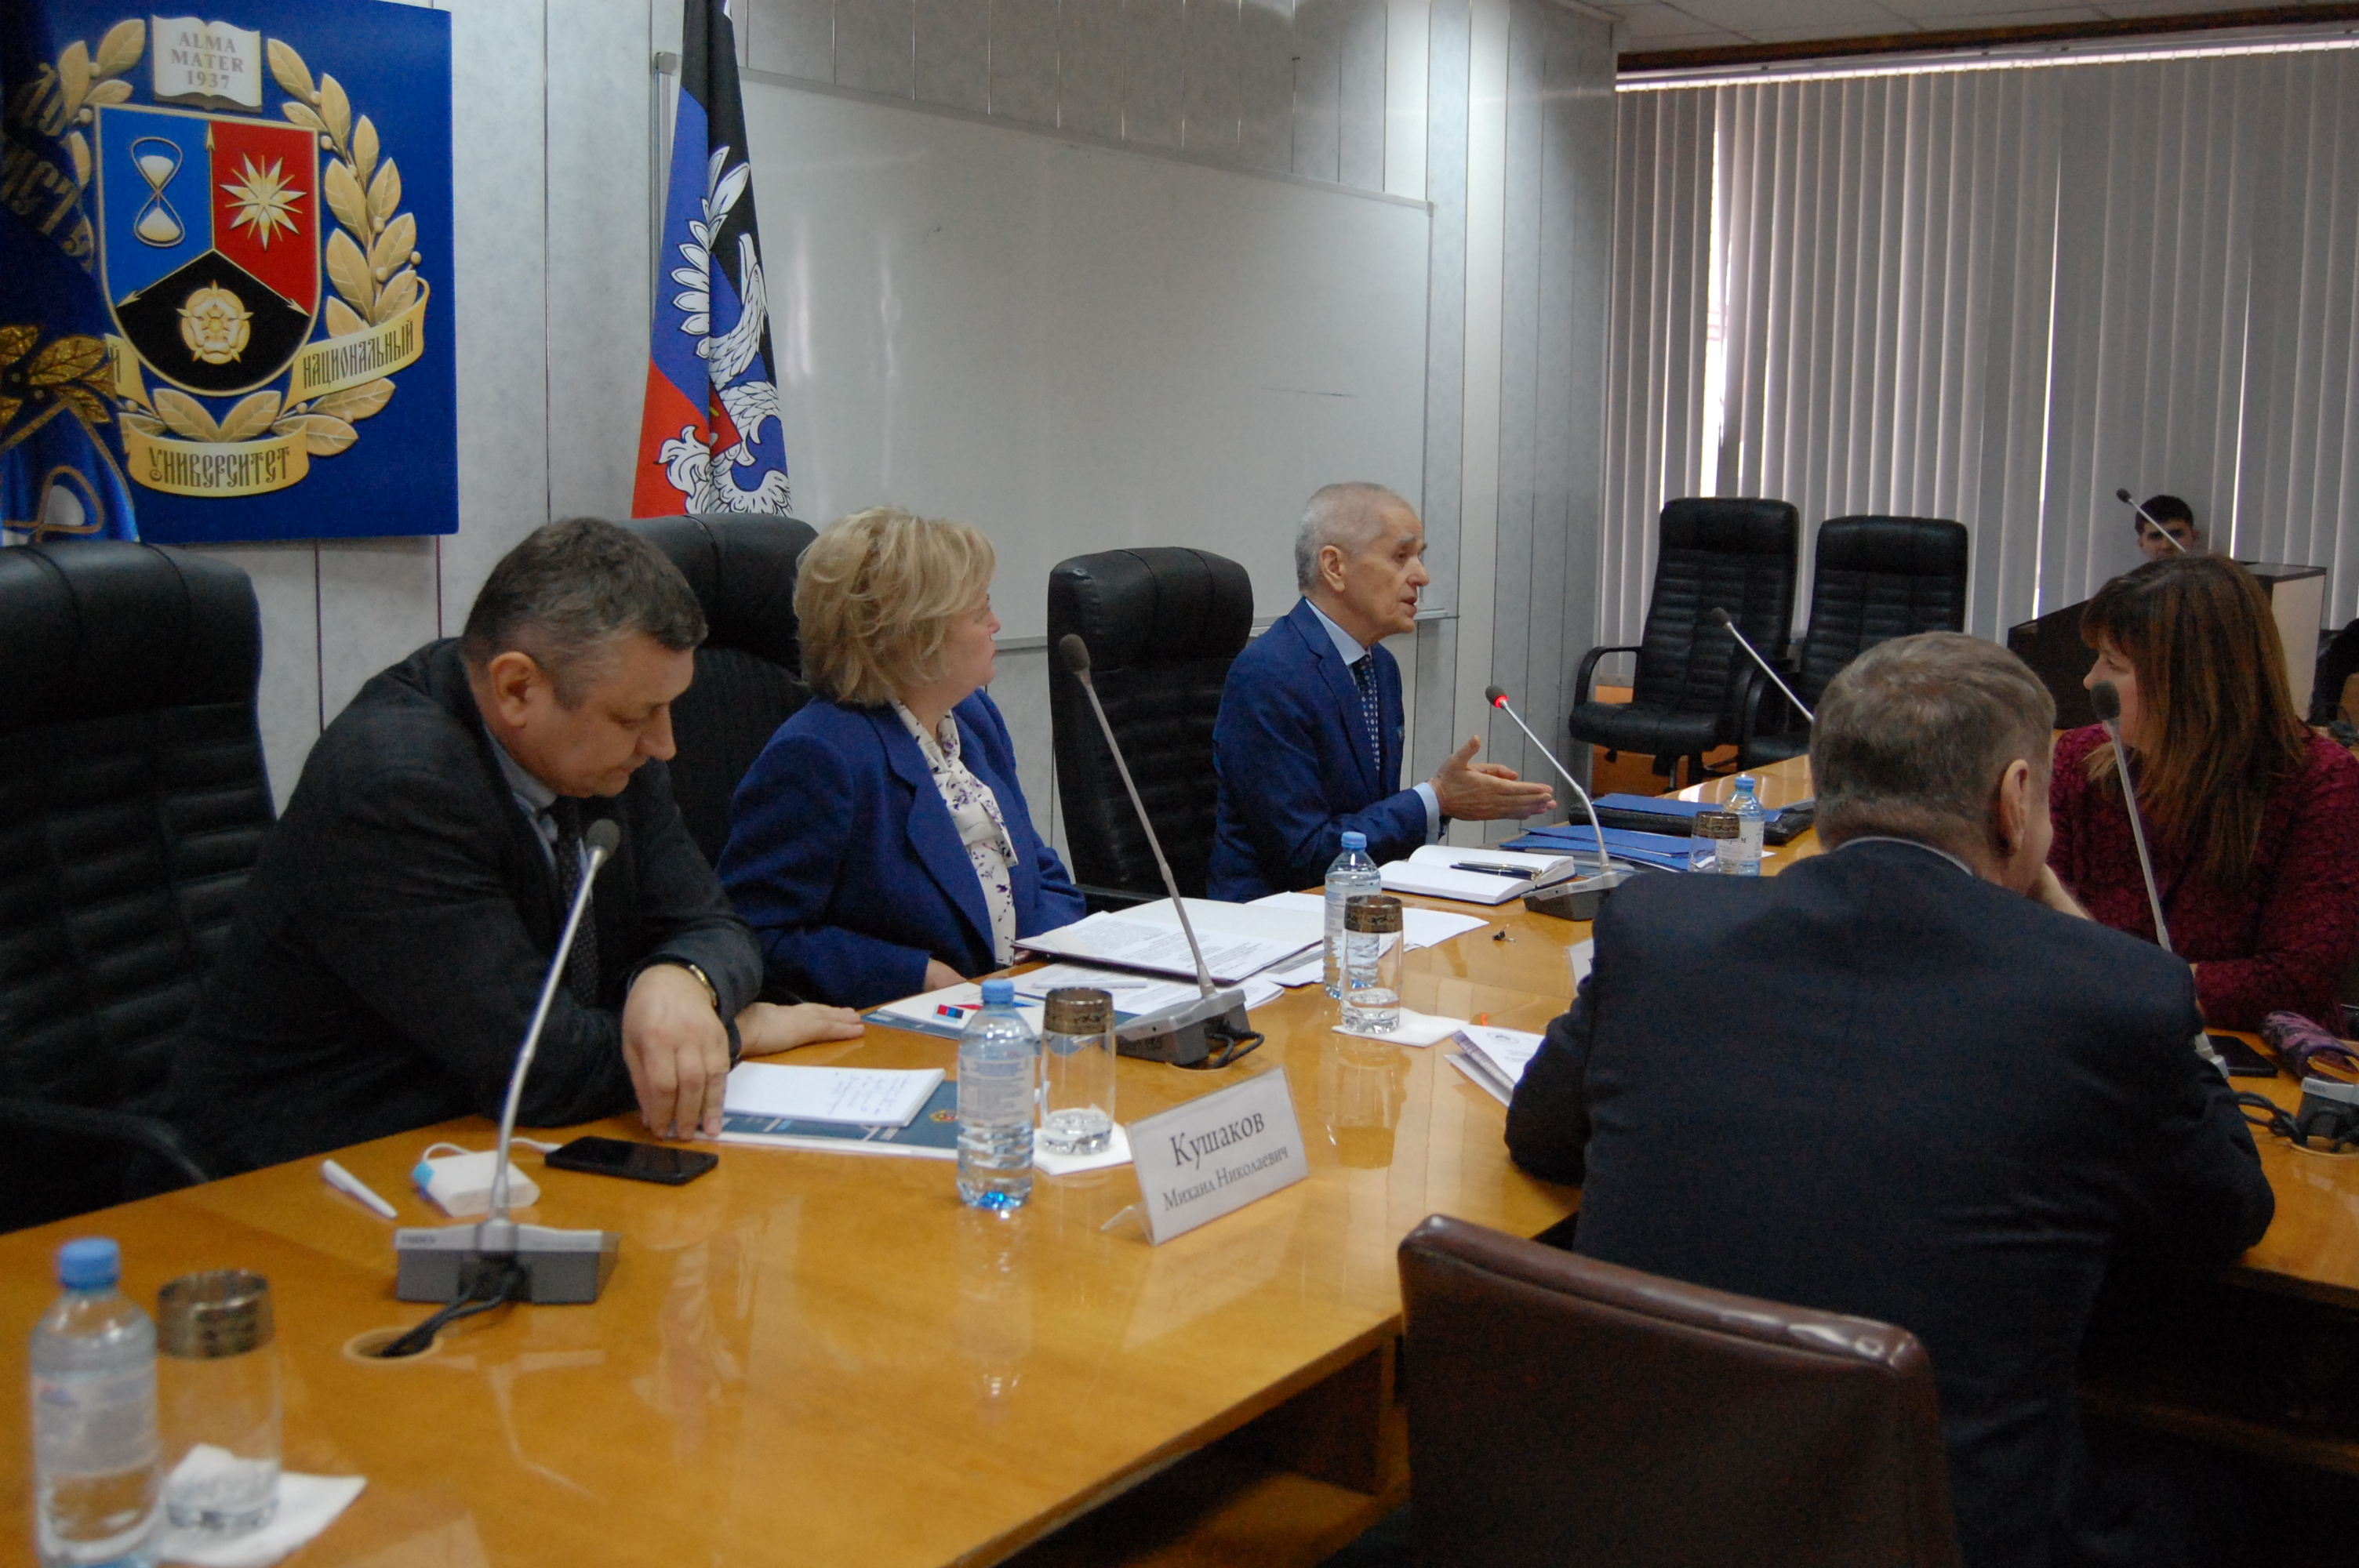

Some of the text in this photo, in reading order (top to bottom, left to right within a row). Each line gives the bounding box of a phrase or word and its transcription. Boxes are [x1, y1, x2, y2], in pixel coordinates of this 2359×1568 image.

[171, 49, 245, 73] MATER
[179, 31, 237, 53] ALMA
[187, 71, 230, 89] 1937
[304, 318, 413, 389] НАЦИОНАЛЬНЫЙ
[149, 446, 290, 488] УНИВЕРСИТЕТ
[1170, 1112, 1265, 1170] Кушаков
[1162, 1146, 1289, 1211] Михаил Николаевич
